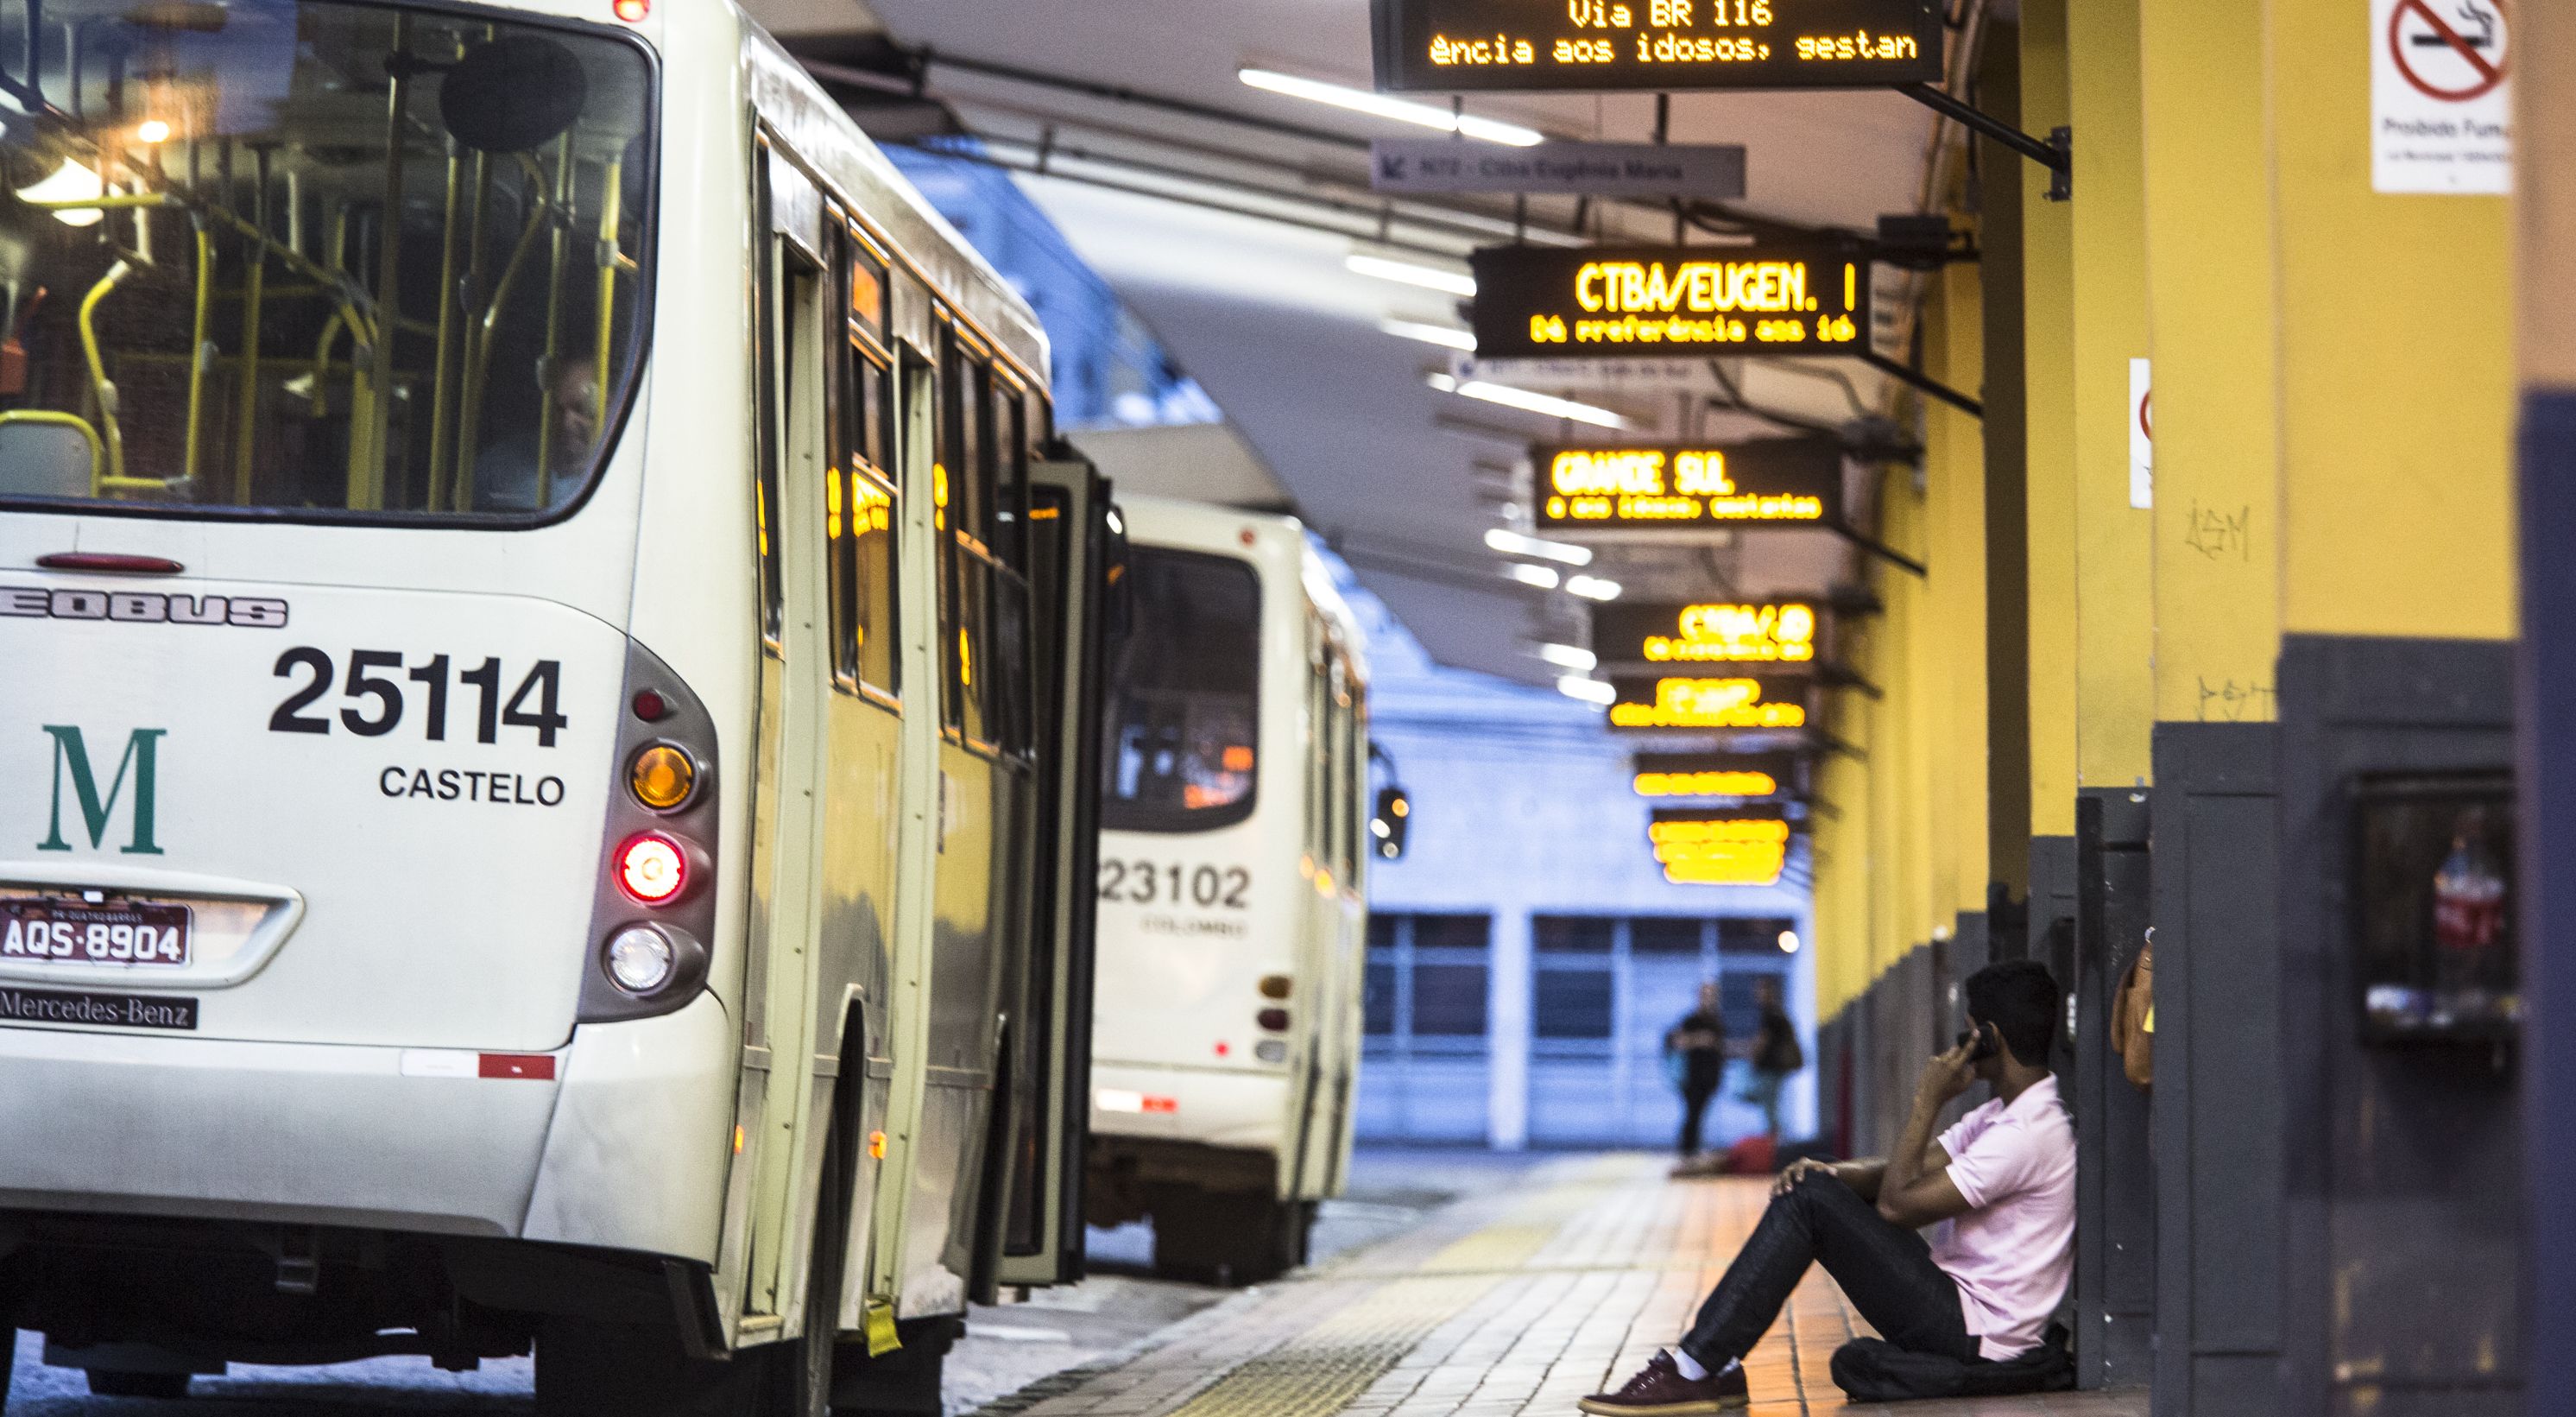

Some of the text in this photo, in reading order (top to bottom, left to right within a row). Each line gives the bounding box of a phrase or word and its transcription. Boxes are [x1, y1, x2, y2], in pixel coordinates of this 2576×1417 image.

[1567, 0, 1773, 28] Via BR 116
[1429, 28, 1917, 66] ência aos idosos, gestan
[1575, 261, 1818, 313] CTBA/EUGEN.
[1551, 450, 1666, 497] GRANDE
[268, 646, 568, 748] 25114
[35, 724, 167, 855] M
[379, 766, 565, 807] CASTELO
[1098, 858, 1250, 908] 23102
[0, 991, 189, 1026] Mercedes-Benz
